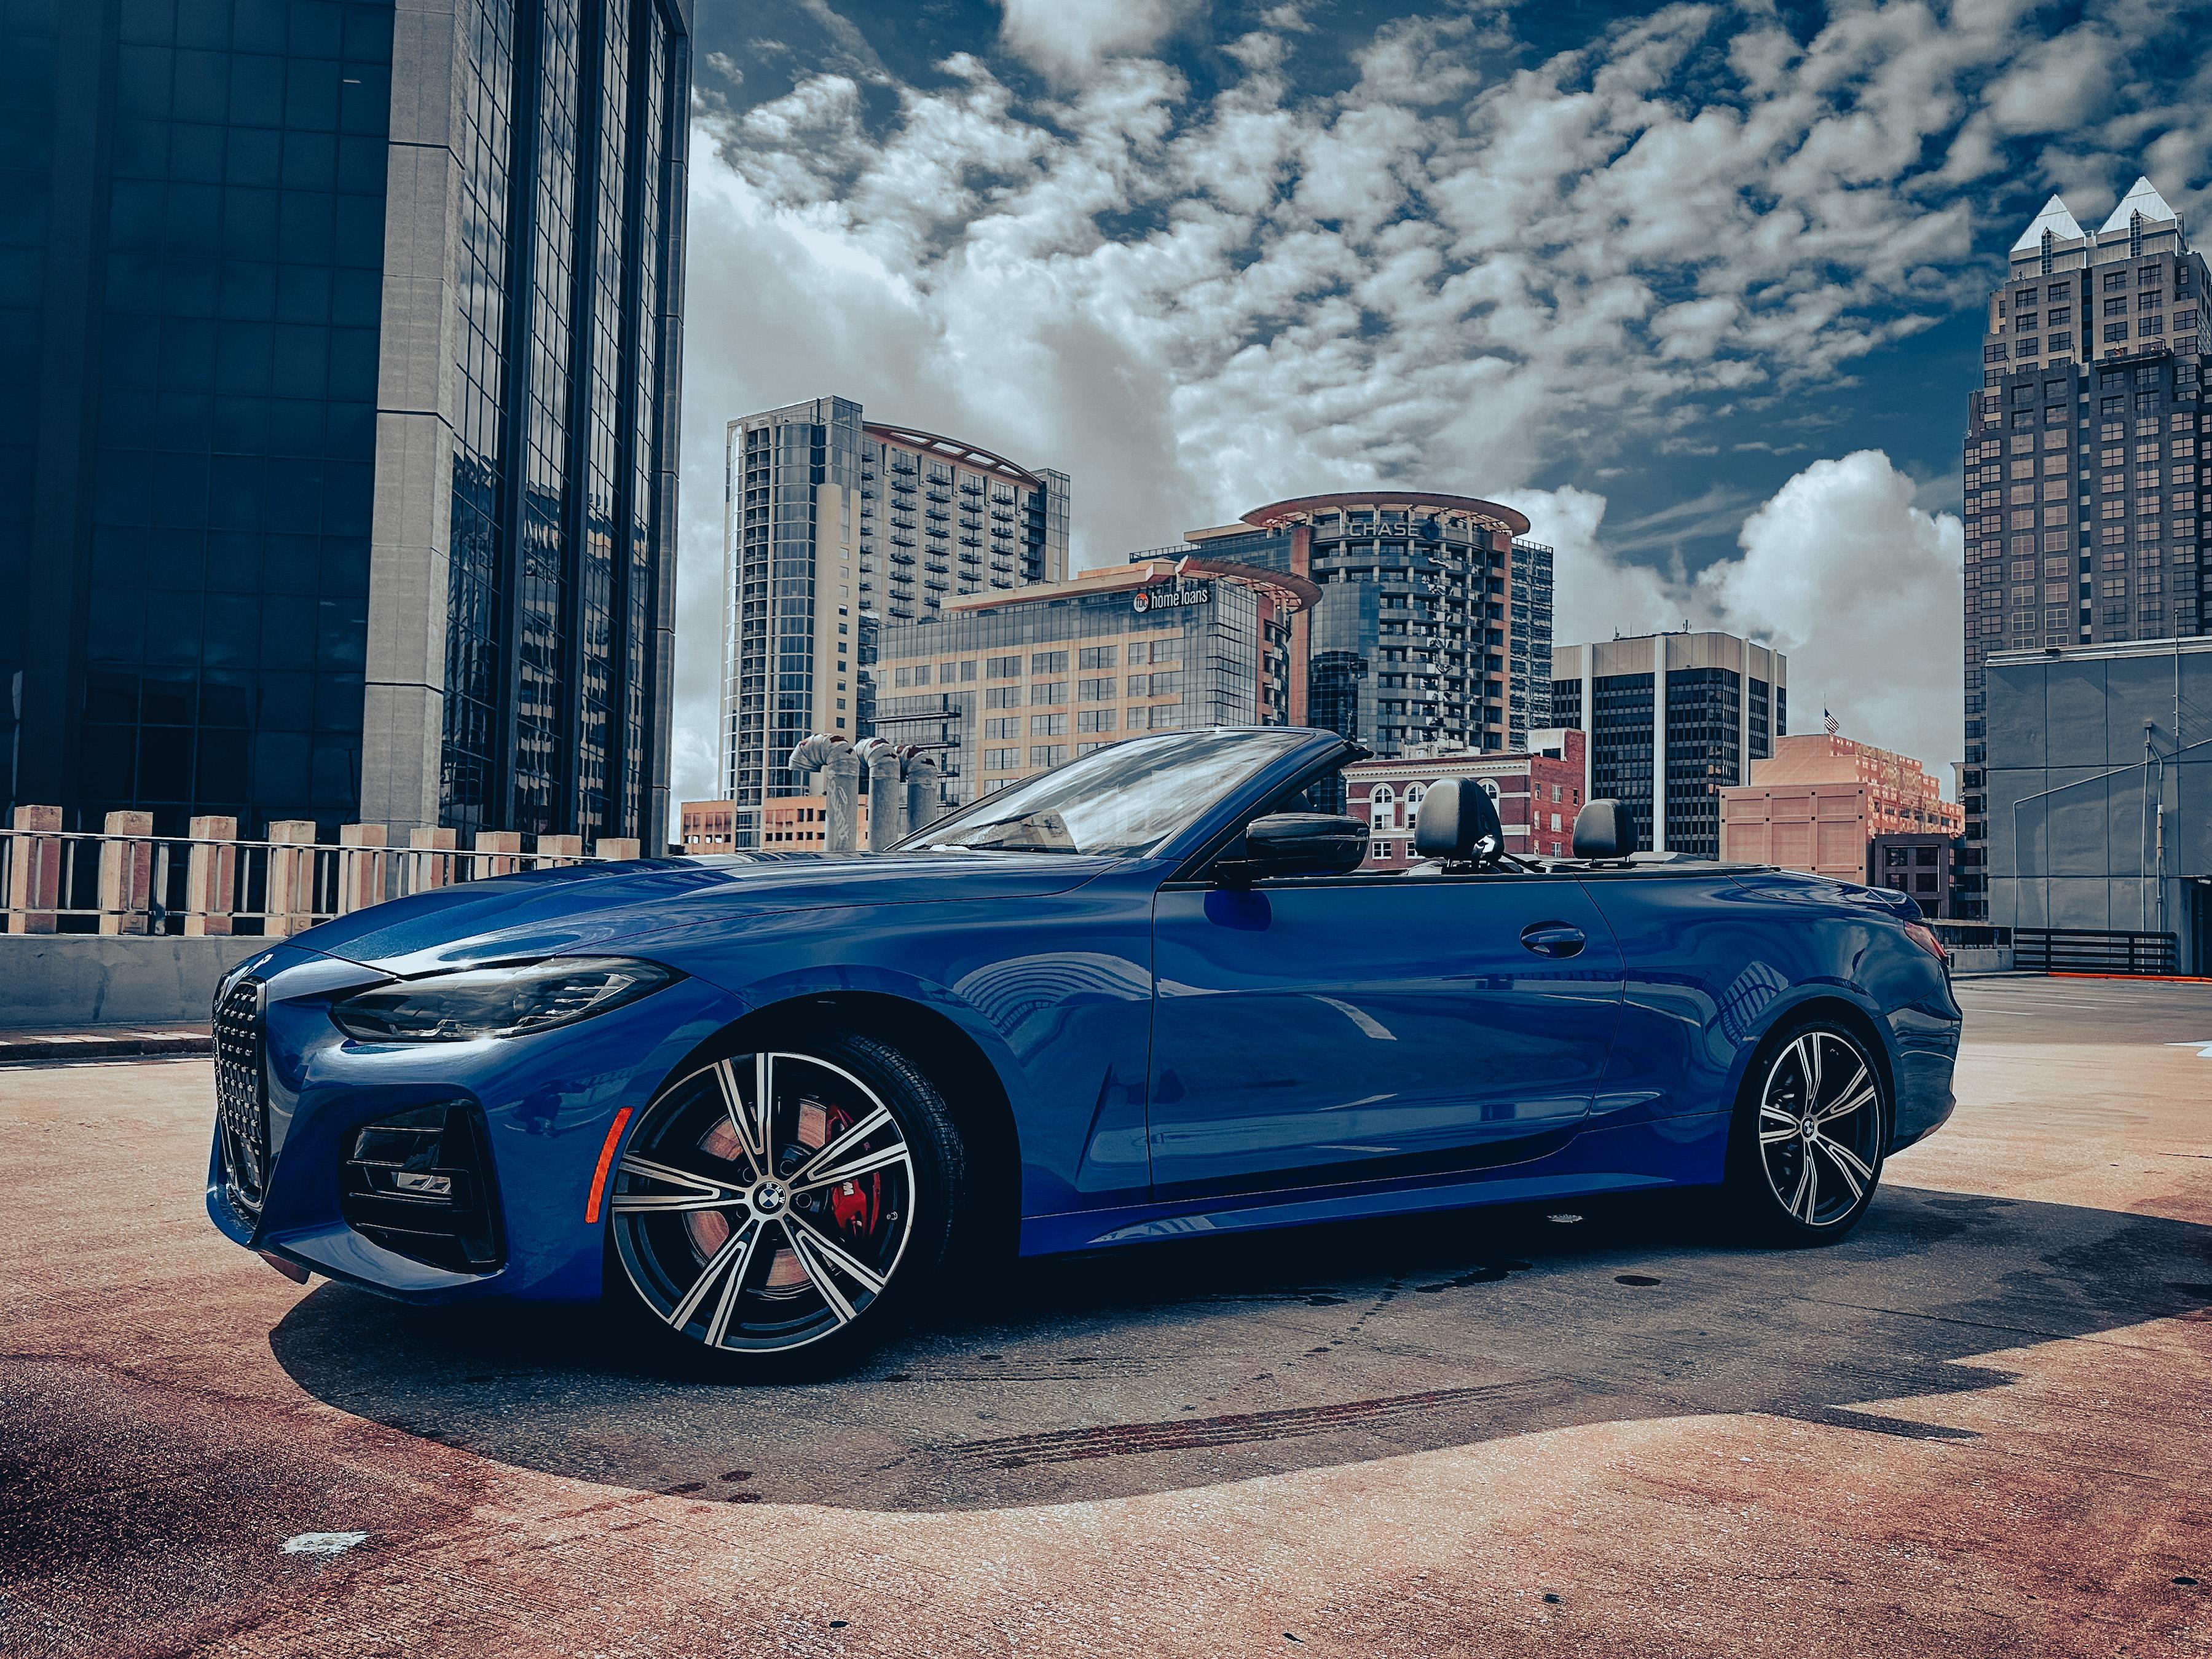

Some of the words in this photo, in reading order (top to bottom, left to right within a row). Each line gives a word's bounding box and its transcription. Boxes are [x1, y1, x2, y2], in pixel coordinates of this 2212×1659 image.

[1349, 522, 1420, 536] CHASE
[1151, 591, 1179, 609] home
[1181, 588, 1208, 605] loans
[766, 1182, 785, 1204] BMW
